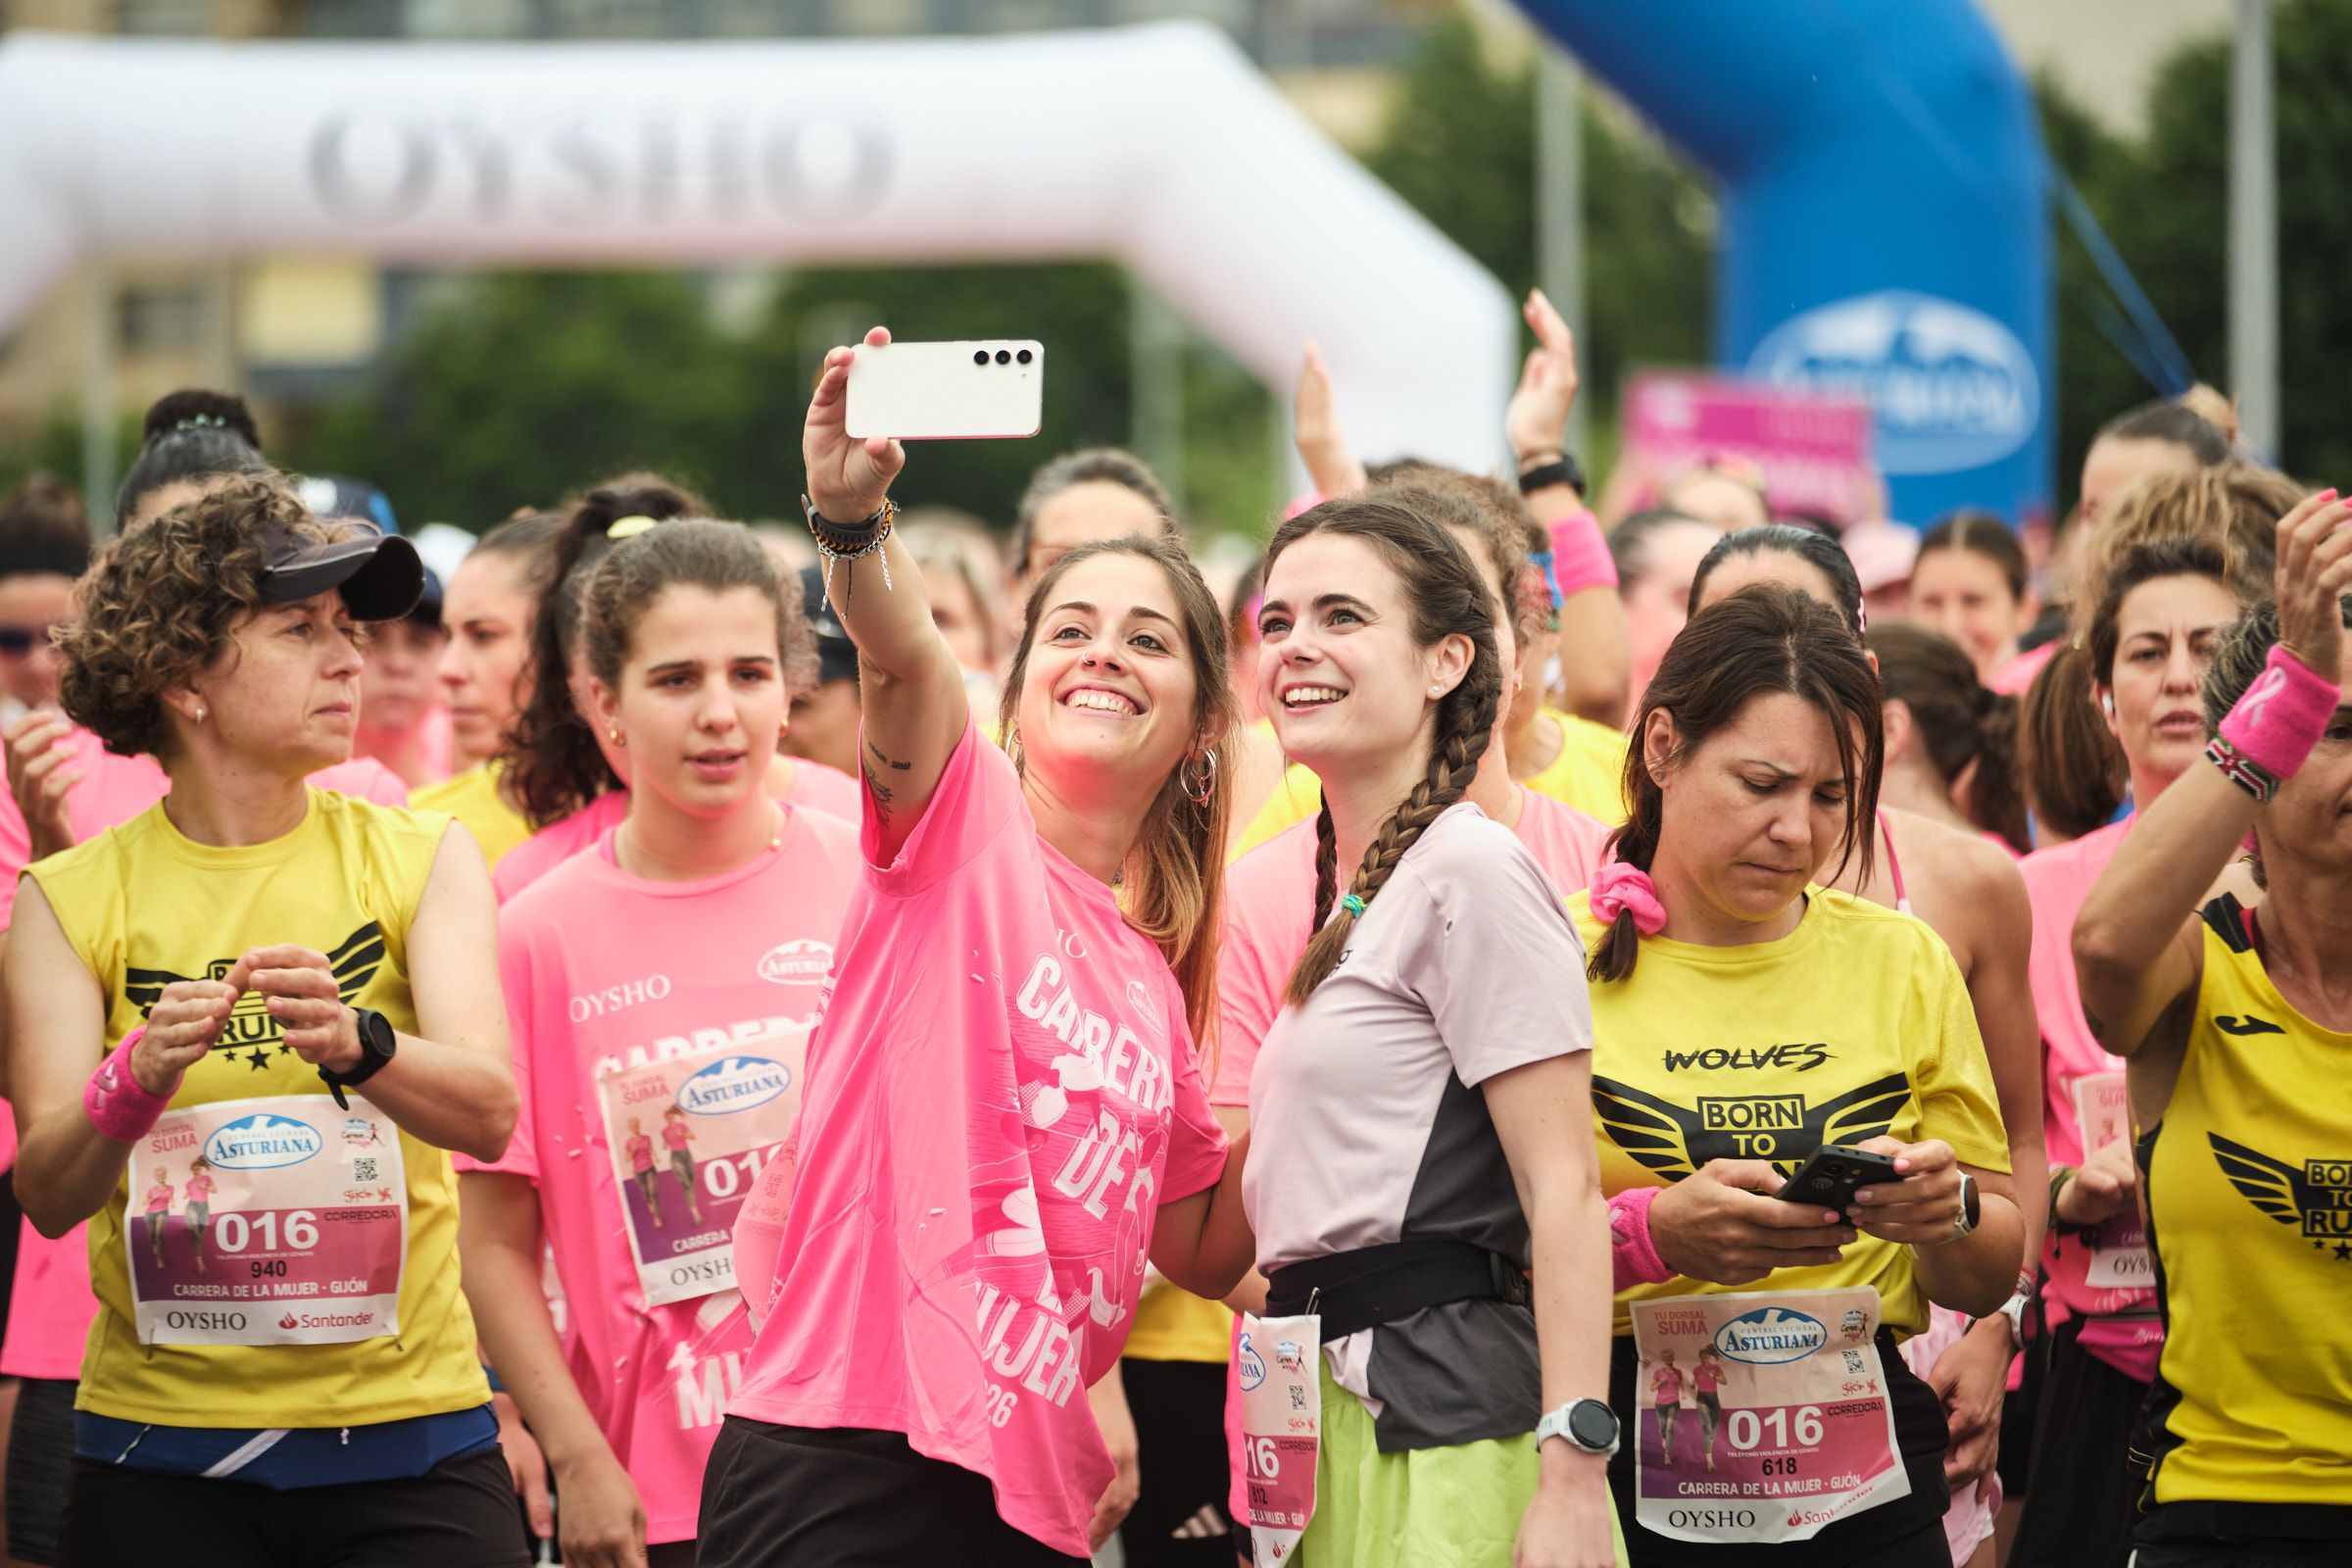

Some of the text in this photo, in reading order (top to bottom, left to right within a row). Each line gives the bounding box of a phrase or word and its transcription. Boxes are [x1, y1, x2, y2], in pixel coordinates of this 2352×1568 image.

[305, 104, 894, 227] OYSHO
[568, 973, 671, 1023] OYSHO
[1663, 1043, 1831, 1073] WOLVES
[622, 1083, 670, 1105] SUMA
[688, 1074, 785, 1108] ASTURIANA
[1706, 1101, 1800, 1128] BORN
[151, 1133, 198, 1153] SUMA
[215, 1138, 315, 1161] ASTURIANA
[1732, 1133, 1777, 1156] TO
[2310, 1164, 2352, 1185] BO
[323, 1209, 397, 1222] CORREDORA
[215, 1209, 320, 1253] 016
[672, 1228, 730, 1253] CARRERA
[250, 1260, 287, 1279] 940
[670, 1256, 733, 1287] OYSH
[173, 1277, 368, 1298] CARRERA DE LA MUJER GIJÓN
[167, 1310, 247, 1331] OYSHO
[301, 1311, 374, 1329] Santander
[1653, 1310, 1706, 1320] TU DORSAL
[1658, 1320, 1708, 1335] SUMA
[1725, 1330, 1818, 1351] ASTURIANA
[1827, 1401, 1884, 1416] CORREDORA
[1728, 1406, 1824, 1450] 016
[1245, 1436, 1280, 1478] 16
[1762, 1457, 1797, 1476] 618
[1679, 1471, 1862, 1494] CARRERA DE LA MUJER GIJÓN
[1263, 1509, 1288, 1526] MUJER
[1668, 1509, 1756, 1528] OYSHO
